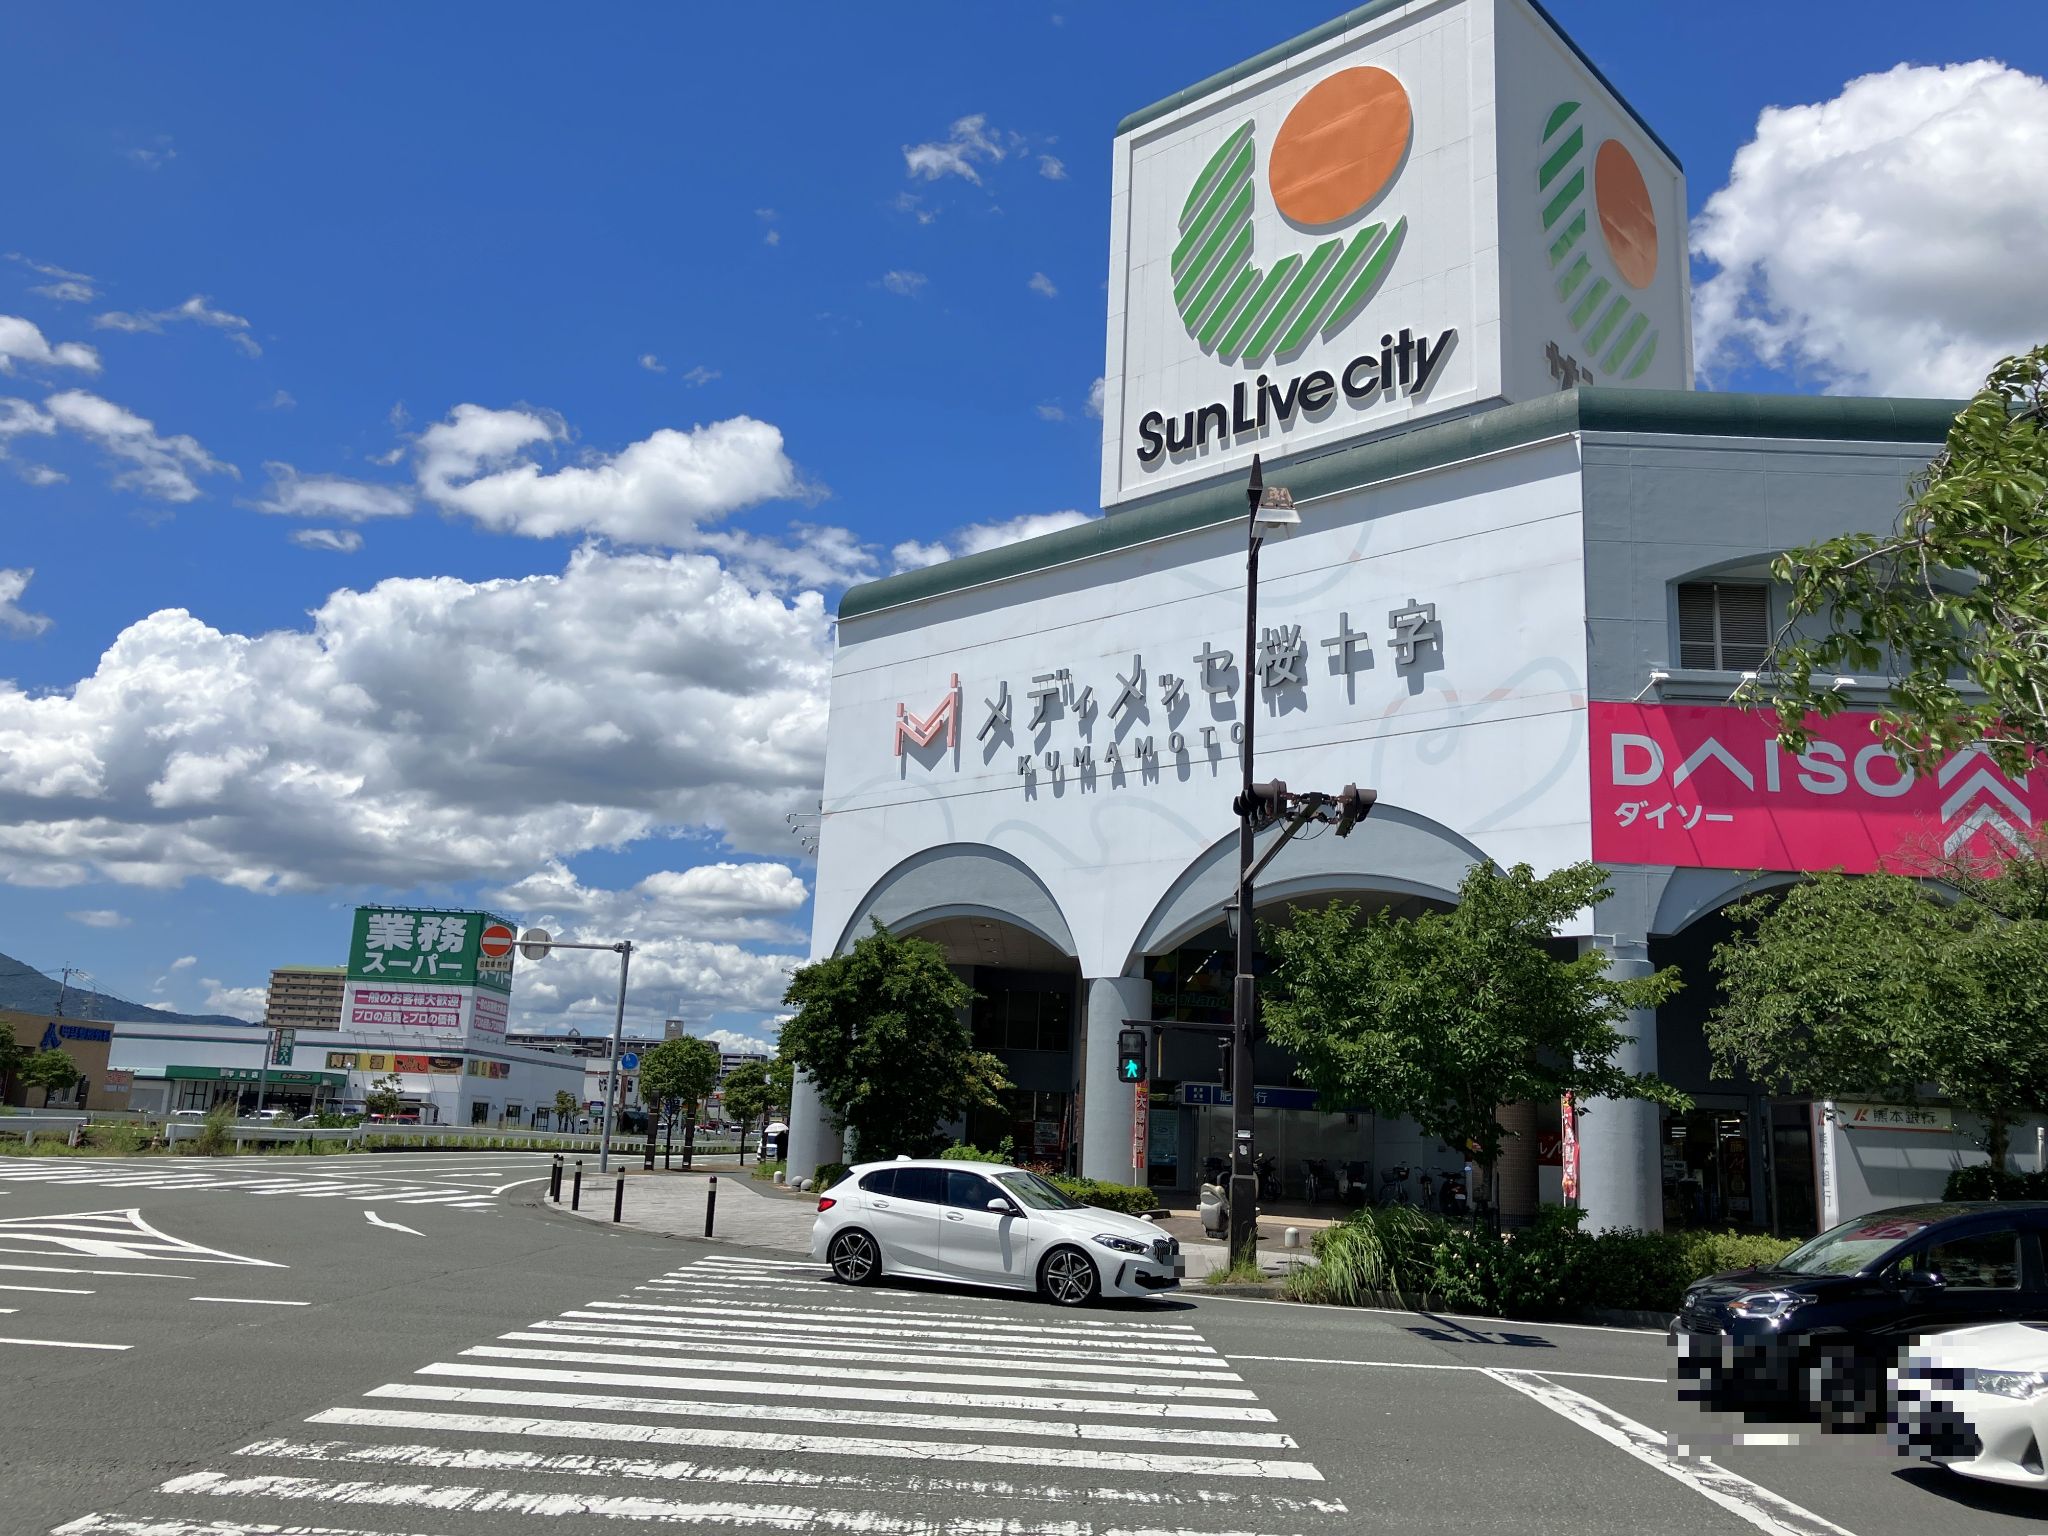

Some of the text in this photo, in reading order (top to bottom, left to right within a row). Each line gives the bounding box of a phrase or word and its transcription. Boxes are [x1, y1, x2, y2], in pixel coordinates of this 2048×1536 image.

[976, 598, 1437, 741] メディメッセ桜十字
[1017, 722, 1246, 776] KUMAMOTO
[1611, 733, 1915, 797] DAISO
[1614, 801, 1734, 830] ダイソー
[366, 912, 468, 952] 業務
[362, 951, 463, 976] スーパー
[357, 992, 460, 1008] 一般のお客様大歓迎
[354, 1010, 457, 1026] プロの品質とプロの価格
[1220, 1090, 1268, 1104] 肥行
[1873, 1107, 1936, 1126] 熊本銀行
